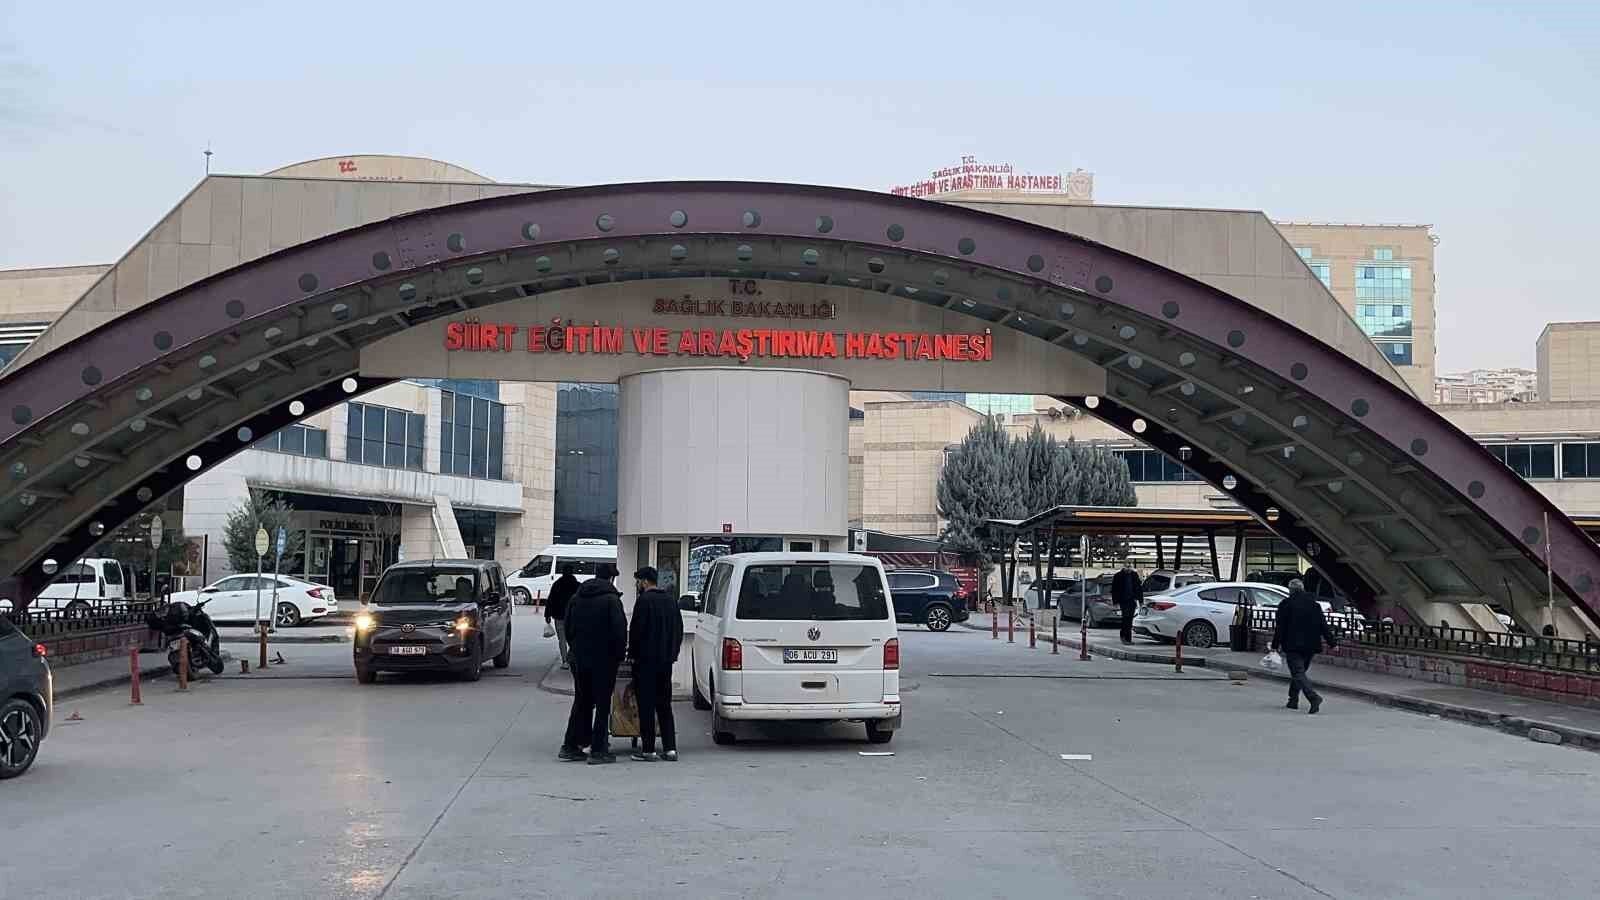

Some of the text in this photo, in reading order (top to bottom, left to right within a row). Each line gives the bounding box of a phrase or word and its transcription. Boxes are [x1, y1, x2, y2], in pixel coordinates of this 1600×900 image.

[932, 166, 962, 180] SAĞLIK
[938, 179, 949, 192] VE
[951, 174, 1003, 192] ARAŞTIRMA
[1007, 173, 1062, 190] HASTANESİ
[729, 279, 762, 296] T.C.
[653, 295, 836, 319] SAĞLIK BAKANLIĞI
[445, 316, 993, 363] SİİRT EĞİTİM VE ARAŞTIRMA HASTANESİ
[789, 650, 835, 660] 06 ACU 291
